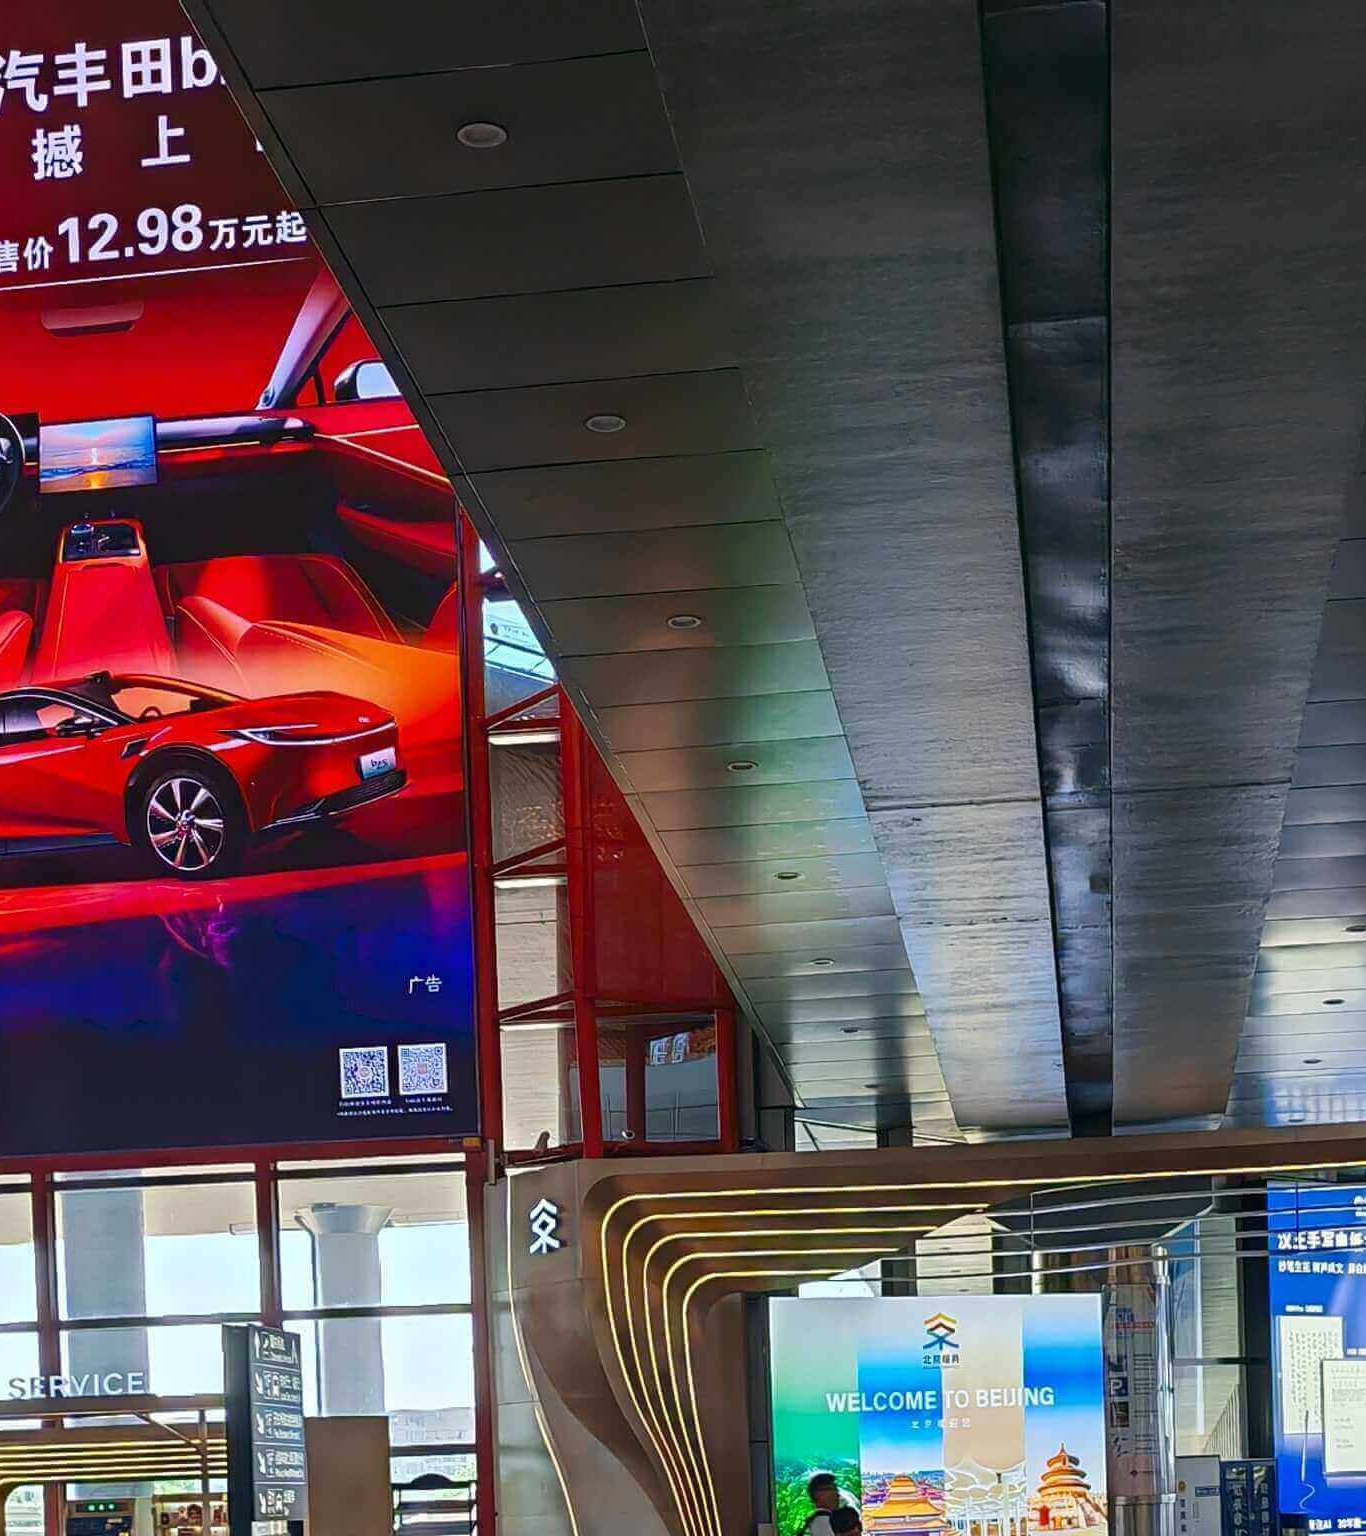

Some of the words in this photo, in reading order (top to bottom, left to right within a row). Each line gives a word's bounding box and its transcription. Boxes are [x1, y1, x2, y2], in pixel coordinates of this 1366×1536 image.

[408, 974, 443, 994] 广告
[8, 1371, 147, 1400] SERVICE
[825, 1389, 938, 1413] WELCOME
[944, 1389, 971, 1410] TO
[975, 1386, 1056, 1409] BEIJING
